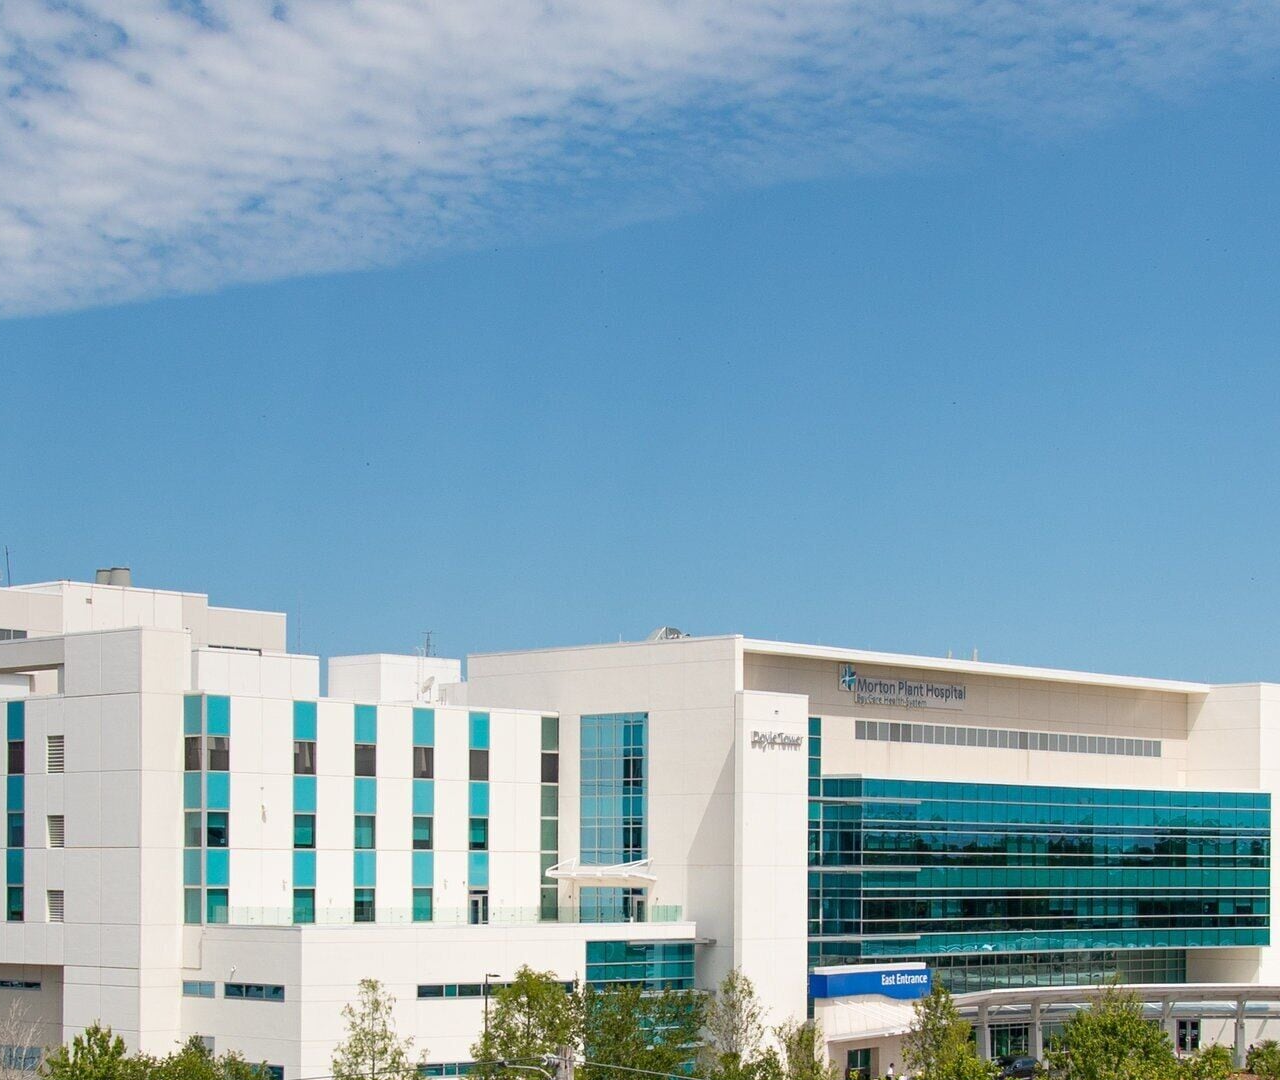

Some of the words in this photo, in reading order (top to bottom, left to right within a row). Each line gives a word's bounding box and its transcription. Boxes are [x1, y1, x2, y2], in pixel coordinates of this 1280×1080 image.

[857, 678, 896, 693] Morton
[898, 681, 924, 697] Plant
[926, 684, 966, 702] Hospital
[777, 732, 803, 745] Tower
[881, 974, 896, 986] East
[896, 973, 928, 985] Entrance
